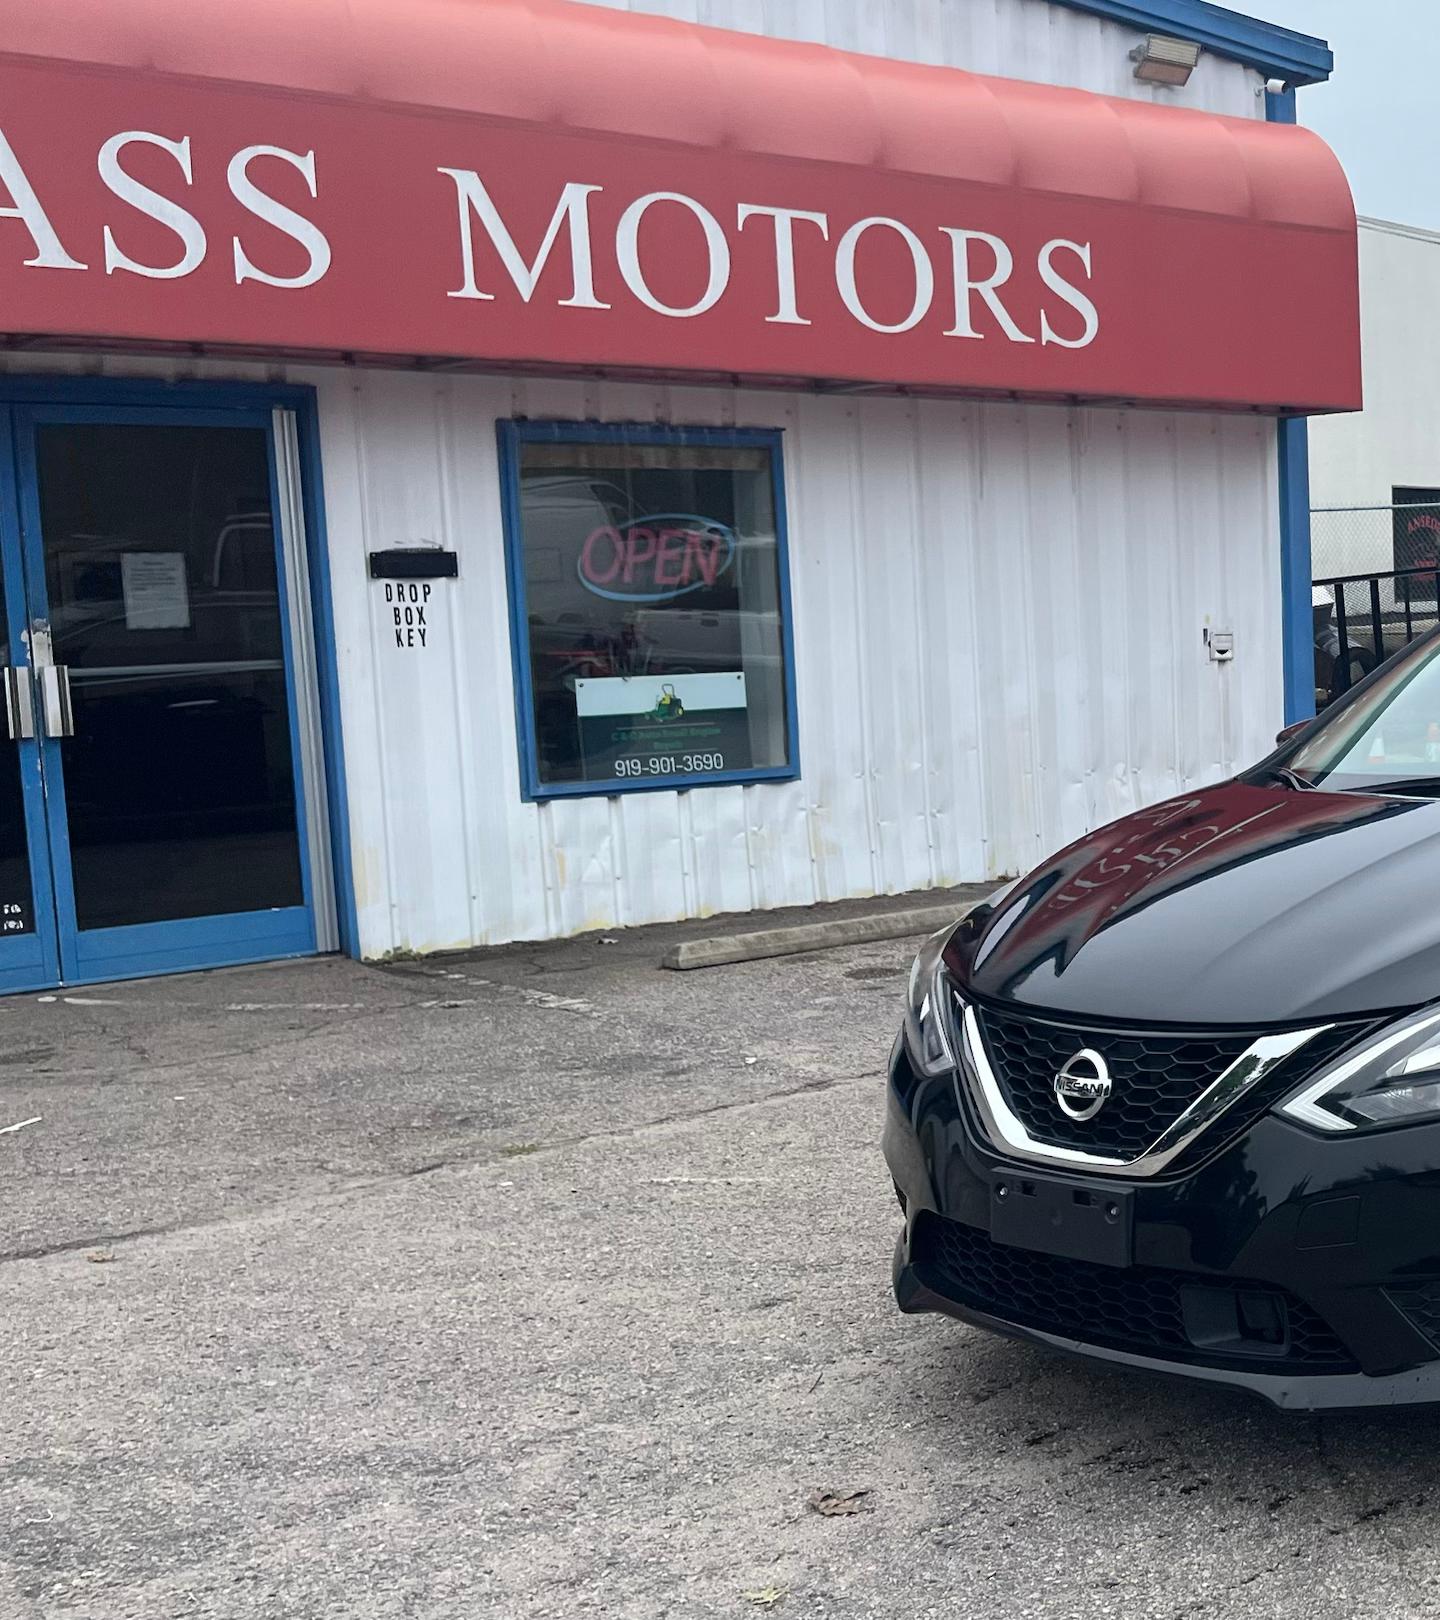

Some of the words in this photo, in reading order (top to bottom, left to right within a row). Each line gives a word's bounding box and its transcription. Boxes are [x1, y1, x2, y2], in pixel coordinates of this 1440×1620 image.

[437, 166, 1099, 349] MOTORS
[581, 525, 722, 586] OPEN
[385, 583, 432, 603] DROP
[394, 606, 427, 626] BOX
[396, 628, 428, 648] KEY
[614, 753, 724, 778] 919-901-3690
[1056, 1078, 1104, 1097] NISSAN
